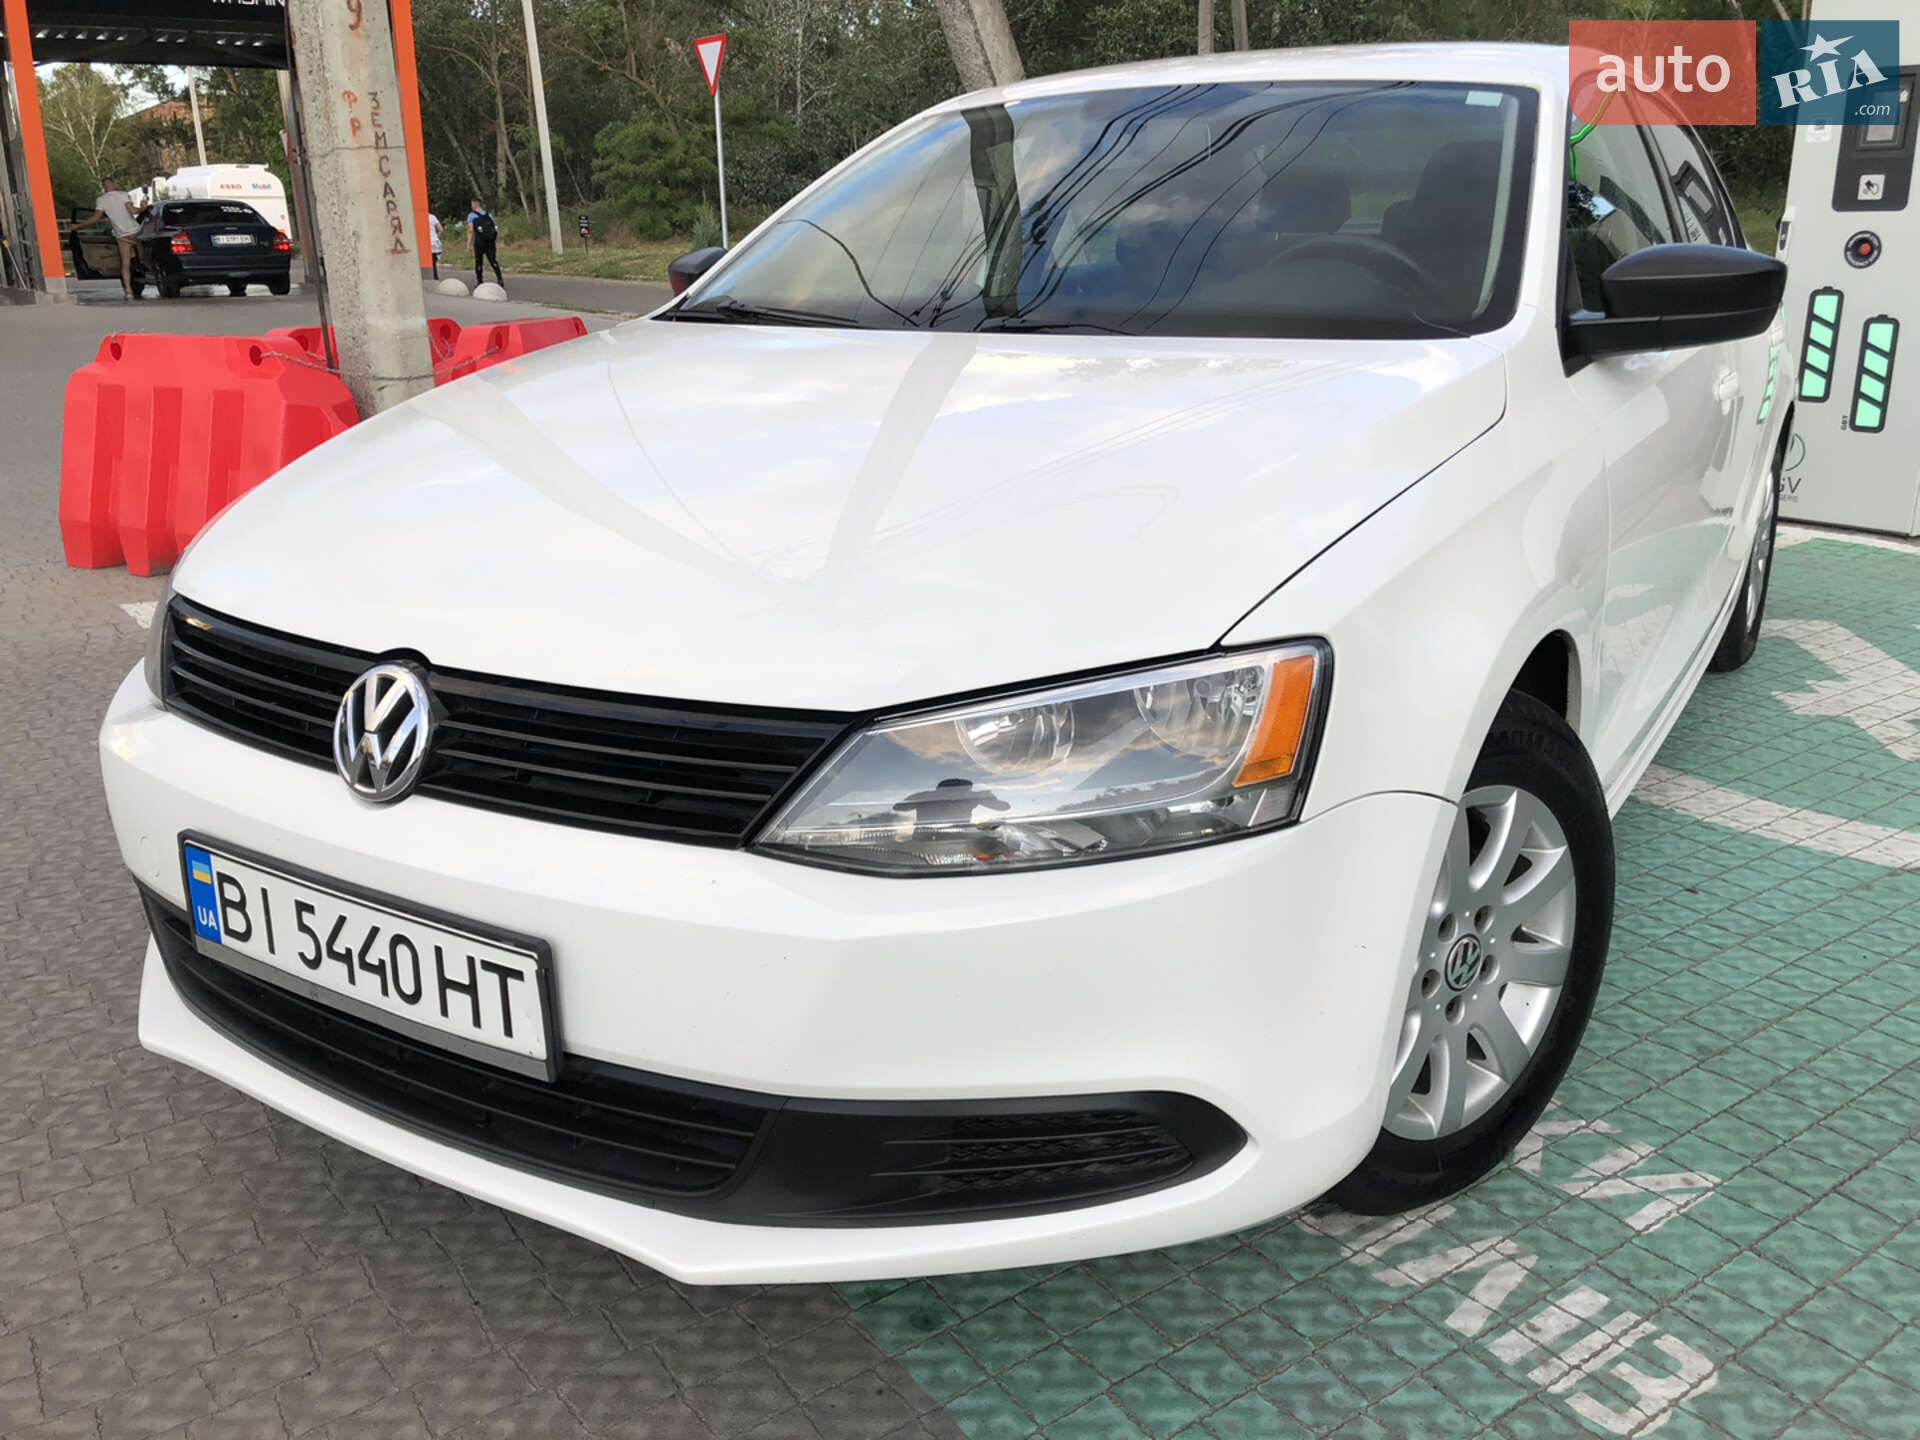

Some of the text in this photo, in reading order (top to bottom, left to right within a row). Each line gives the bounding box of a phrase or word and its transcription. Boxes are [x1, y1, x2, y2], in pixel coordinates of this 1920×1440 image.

[197, 907, 218, 931] UA
[216, 870, 525, 1039] BI 5440 HT
